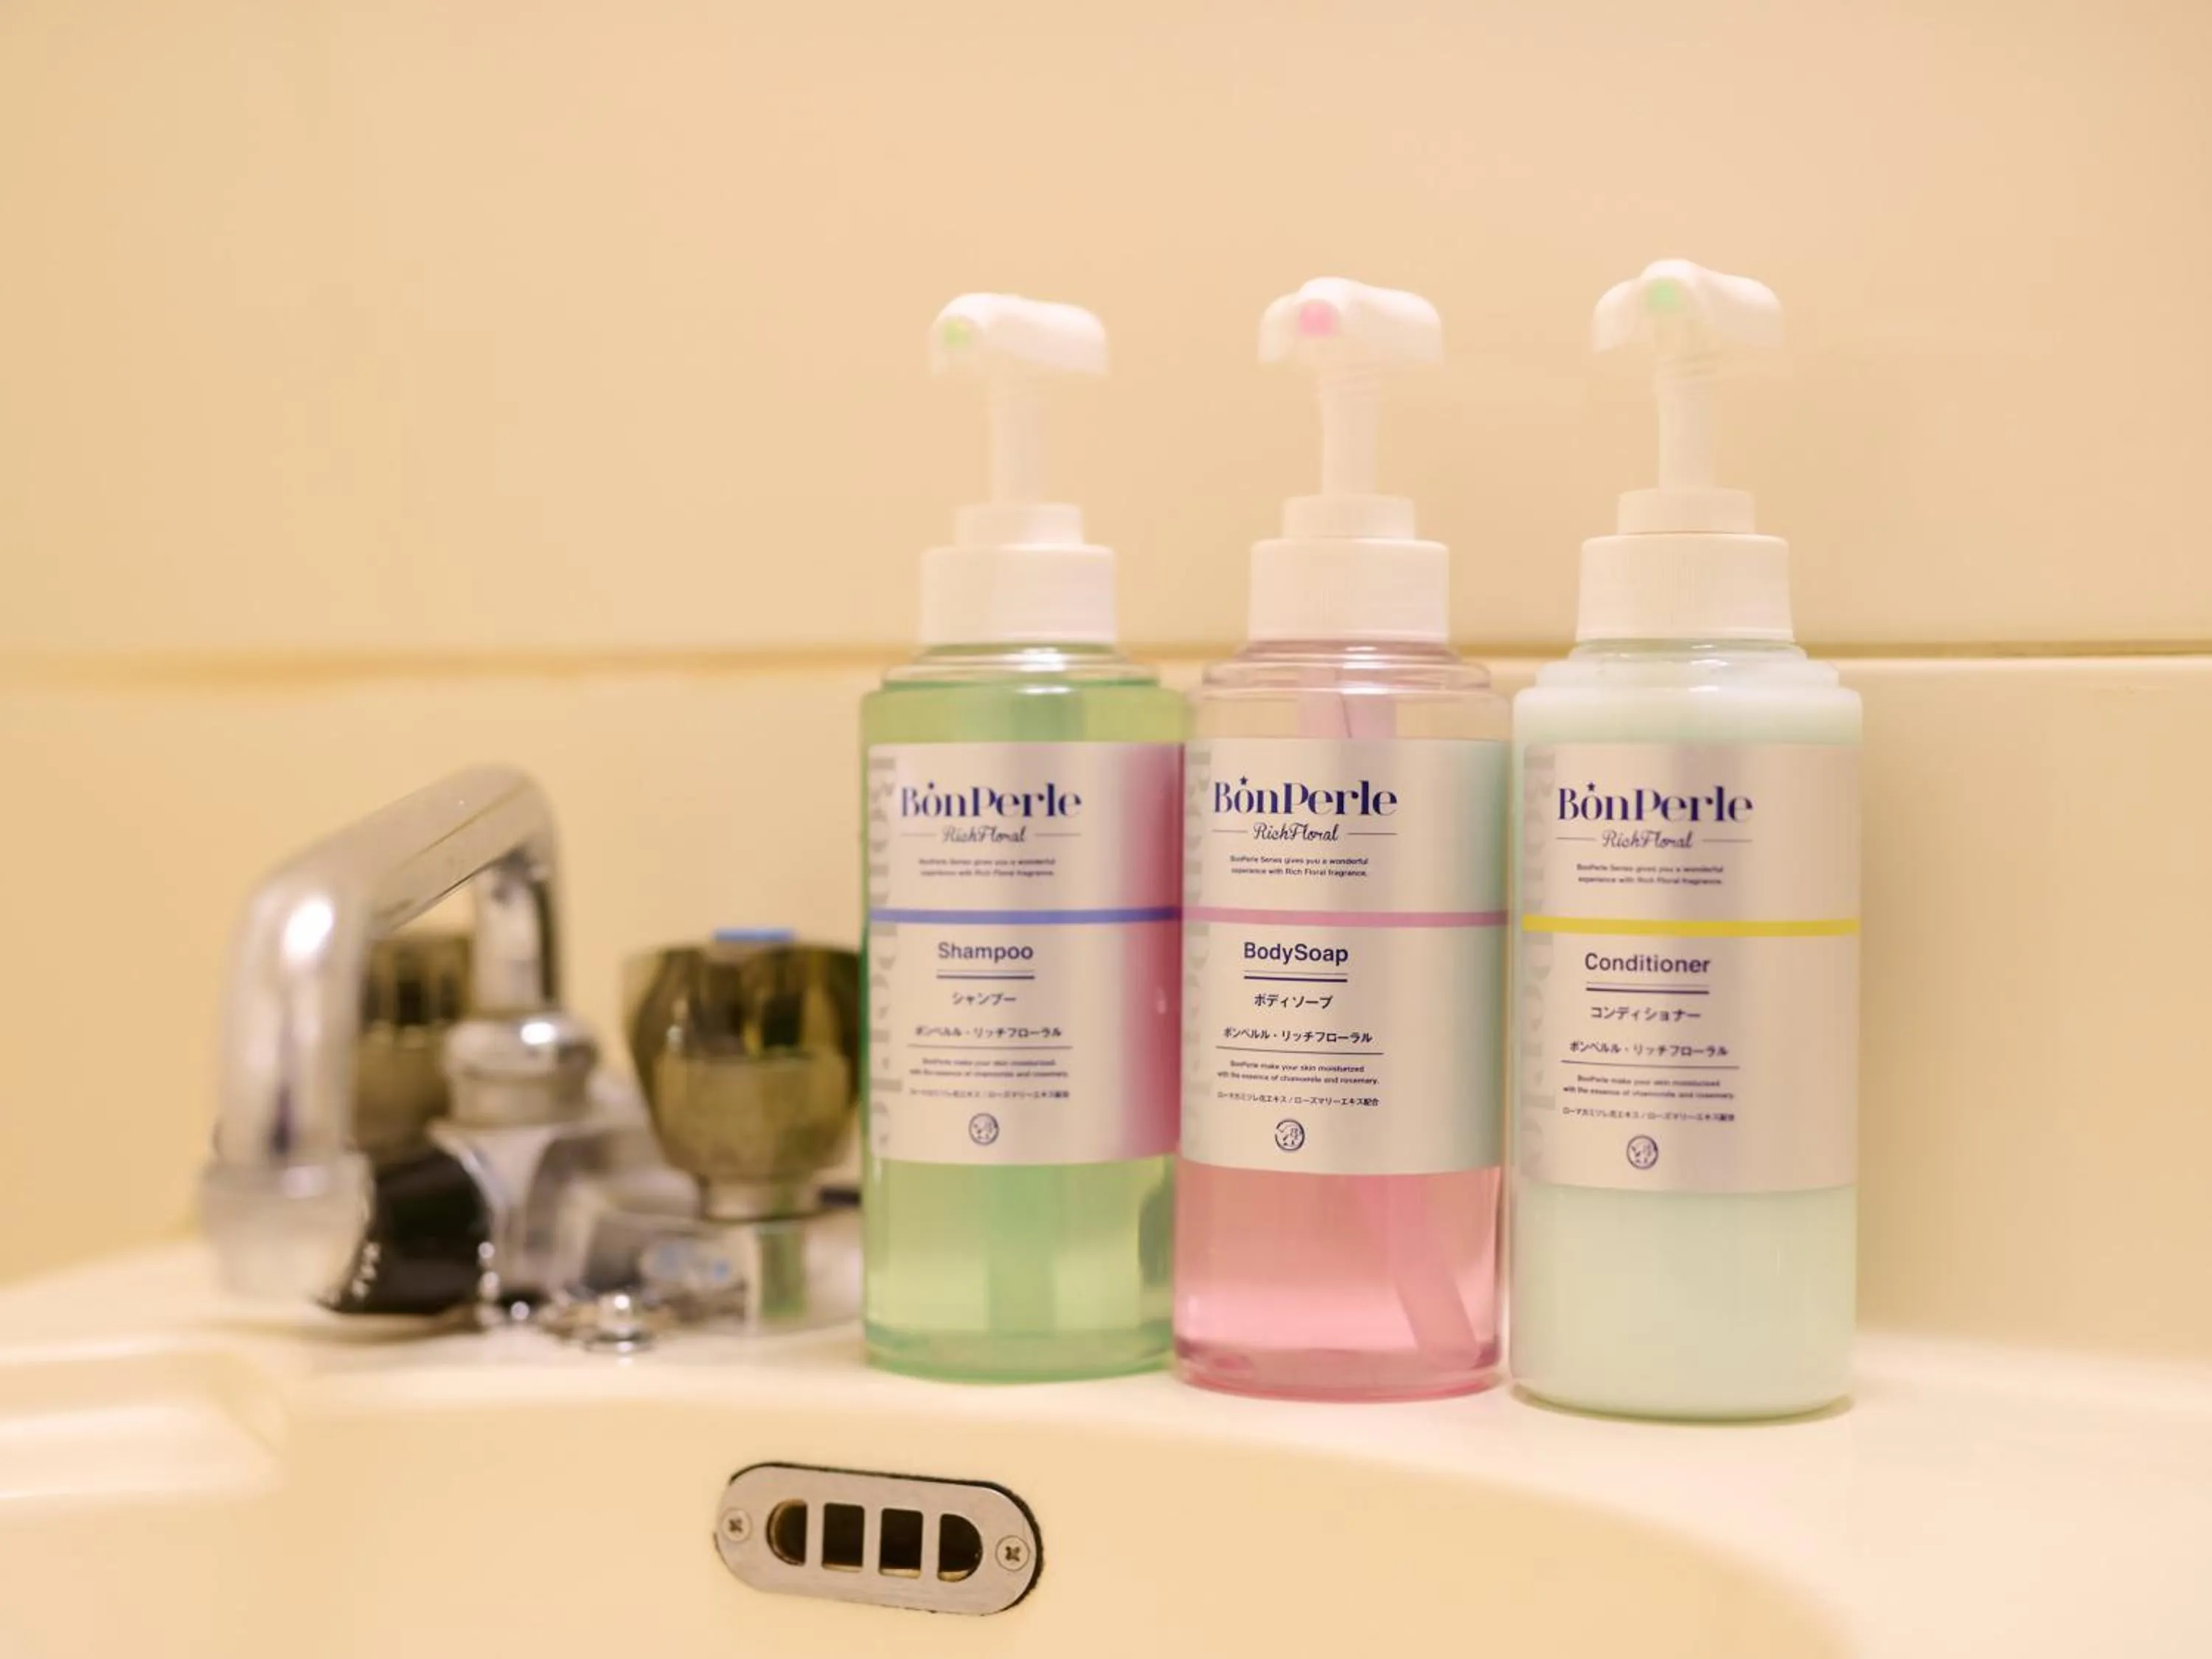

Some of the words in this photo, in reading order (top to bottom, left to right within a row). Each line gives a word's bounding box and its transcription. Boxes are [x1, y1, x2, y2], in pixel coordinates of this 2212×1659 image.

[1214, 776, 1398, 816] BonPerle
[1557, 782, 1753, 822] BonPerle
[1329, 858, 1369, 866] wonderful
[938, 942, 1034, 964] Shampoo
[1244, 942, 1349, 966] BodySoap
[1585, 953, 1711, 973] Conditioner
[1254, 992, 1334, 1009] ボディソープ
[1590, 1006, 1702, 1022] コンディショナー
